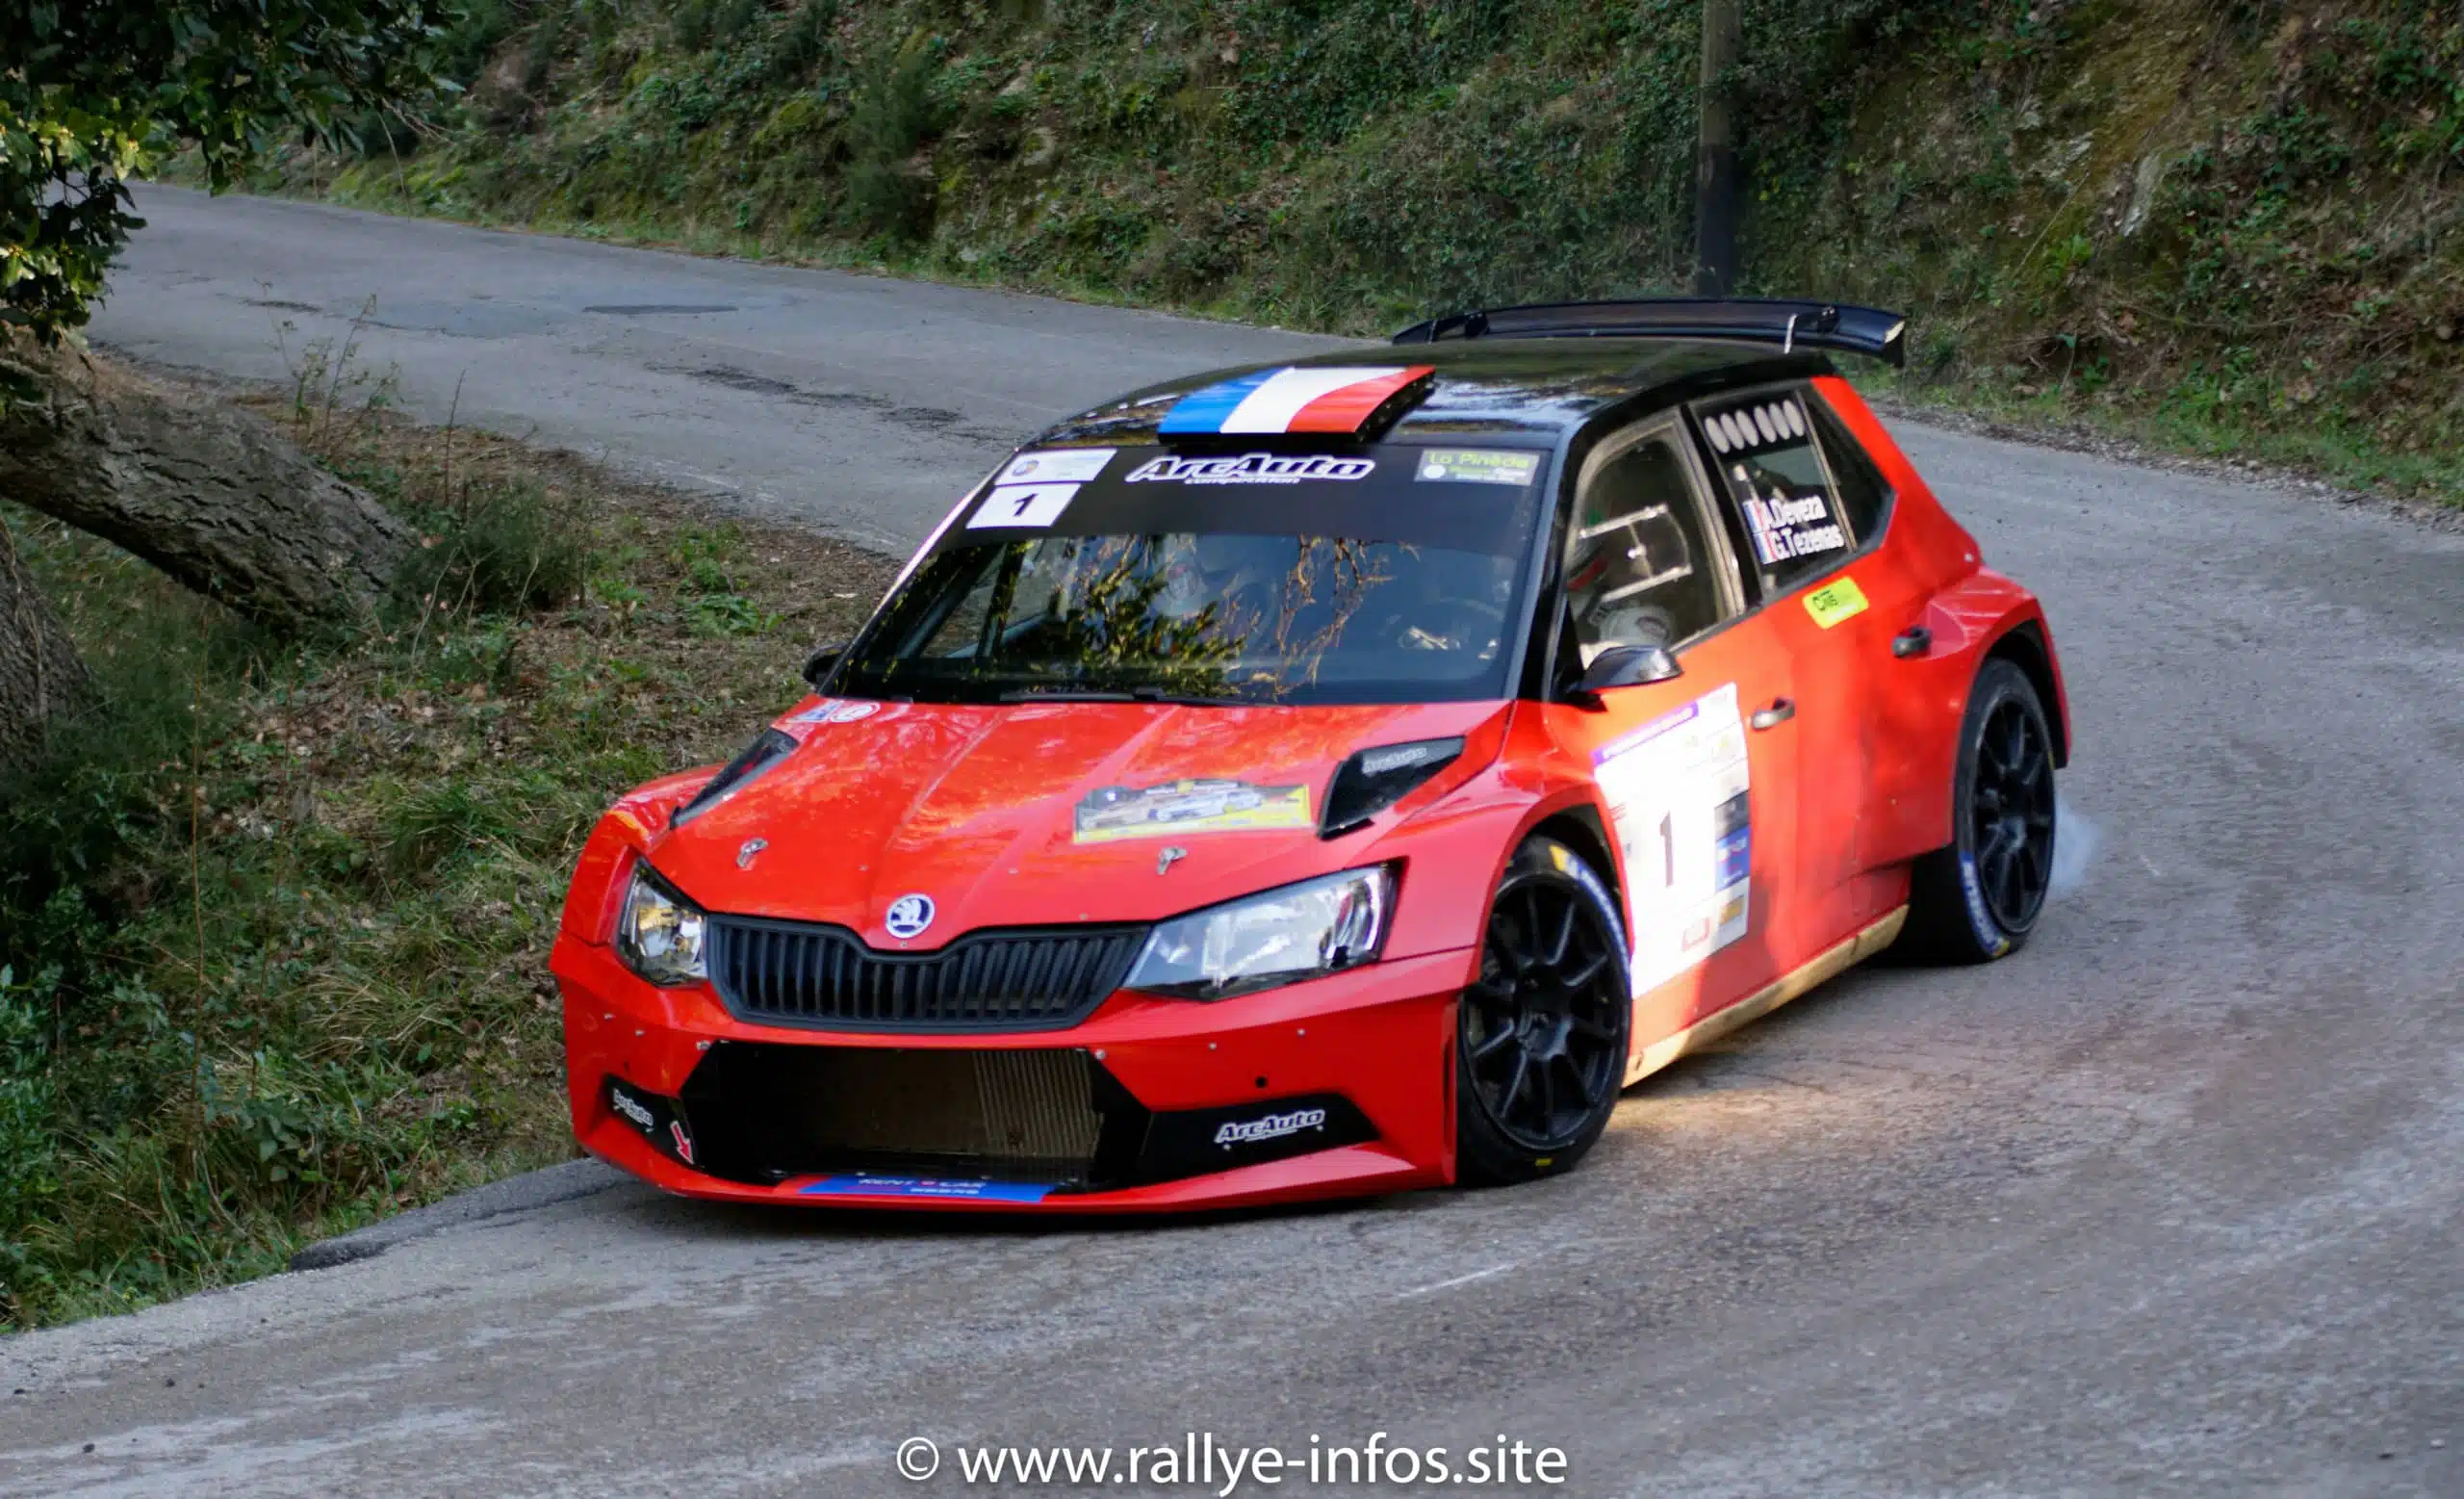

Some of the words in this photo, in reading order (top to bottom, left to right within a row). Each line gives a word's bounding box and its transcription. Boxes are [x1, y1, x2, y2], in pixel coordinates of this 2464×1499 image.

[1125, 452, 1376, 482] ArcAuto
[1014, 492, 1040, 517] 1
[1658, 810, 1675, 888] 1
[1214, 1109, 1326, 1144] ArcAuto
